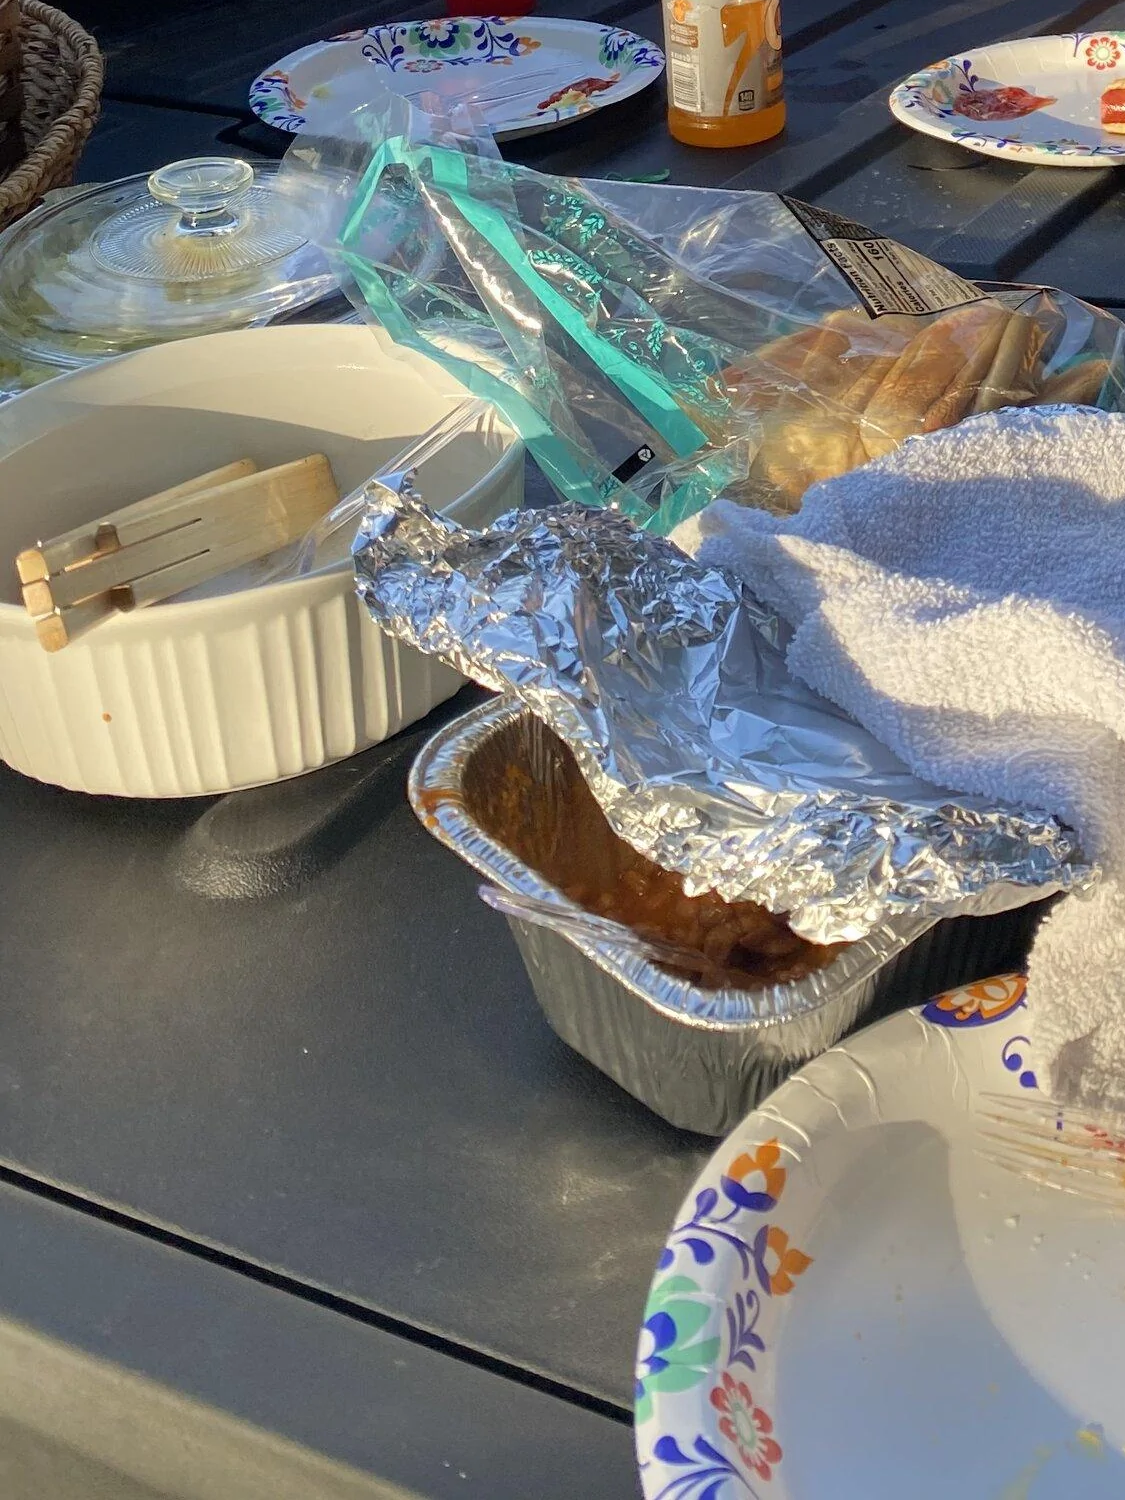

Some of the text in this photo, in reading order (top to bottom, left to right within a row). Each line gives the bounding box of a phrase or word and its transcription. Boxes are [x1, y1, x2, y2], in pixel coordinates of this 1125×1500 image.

[826, 242, 851, 270] Facts
[862, 241, 884, 261] 160
[849, 270, 888, 313] Nutrition
[898, 280, 925, 313] Calories
